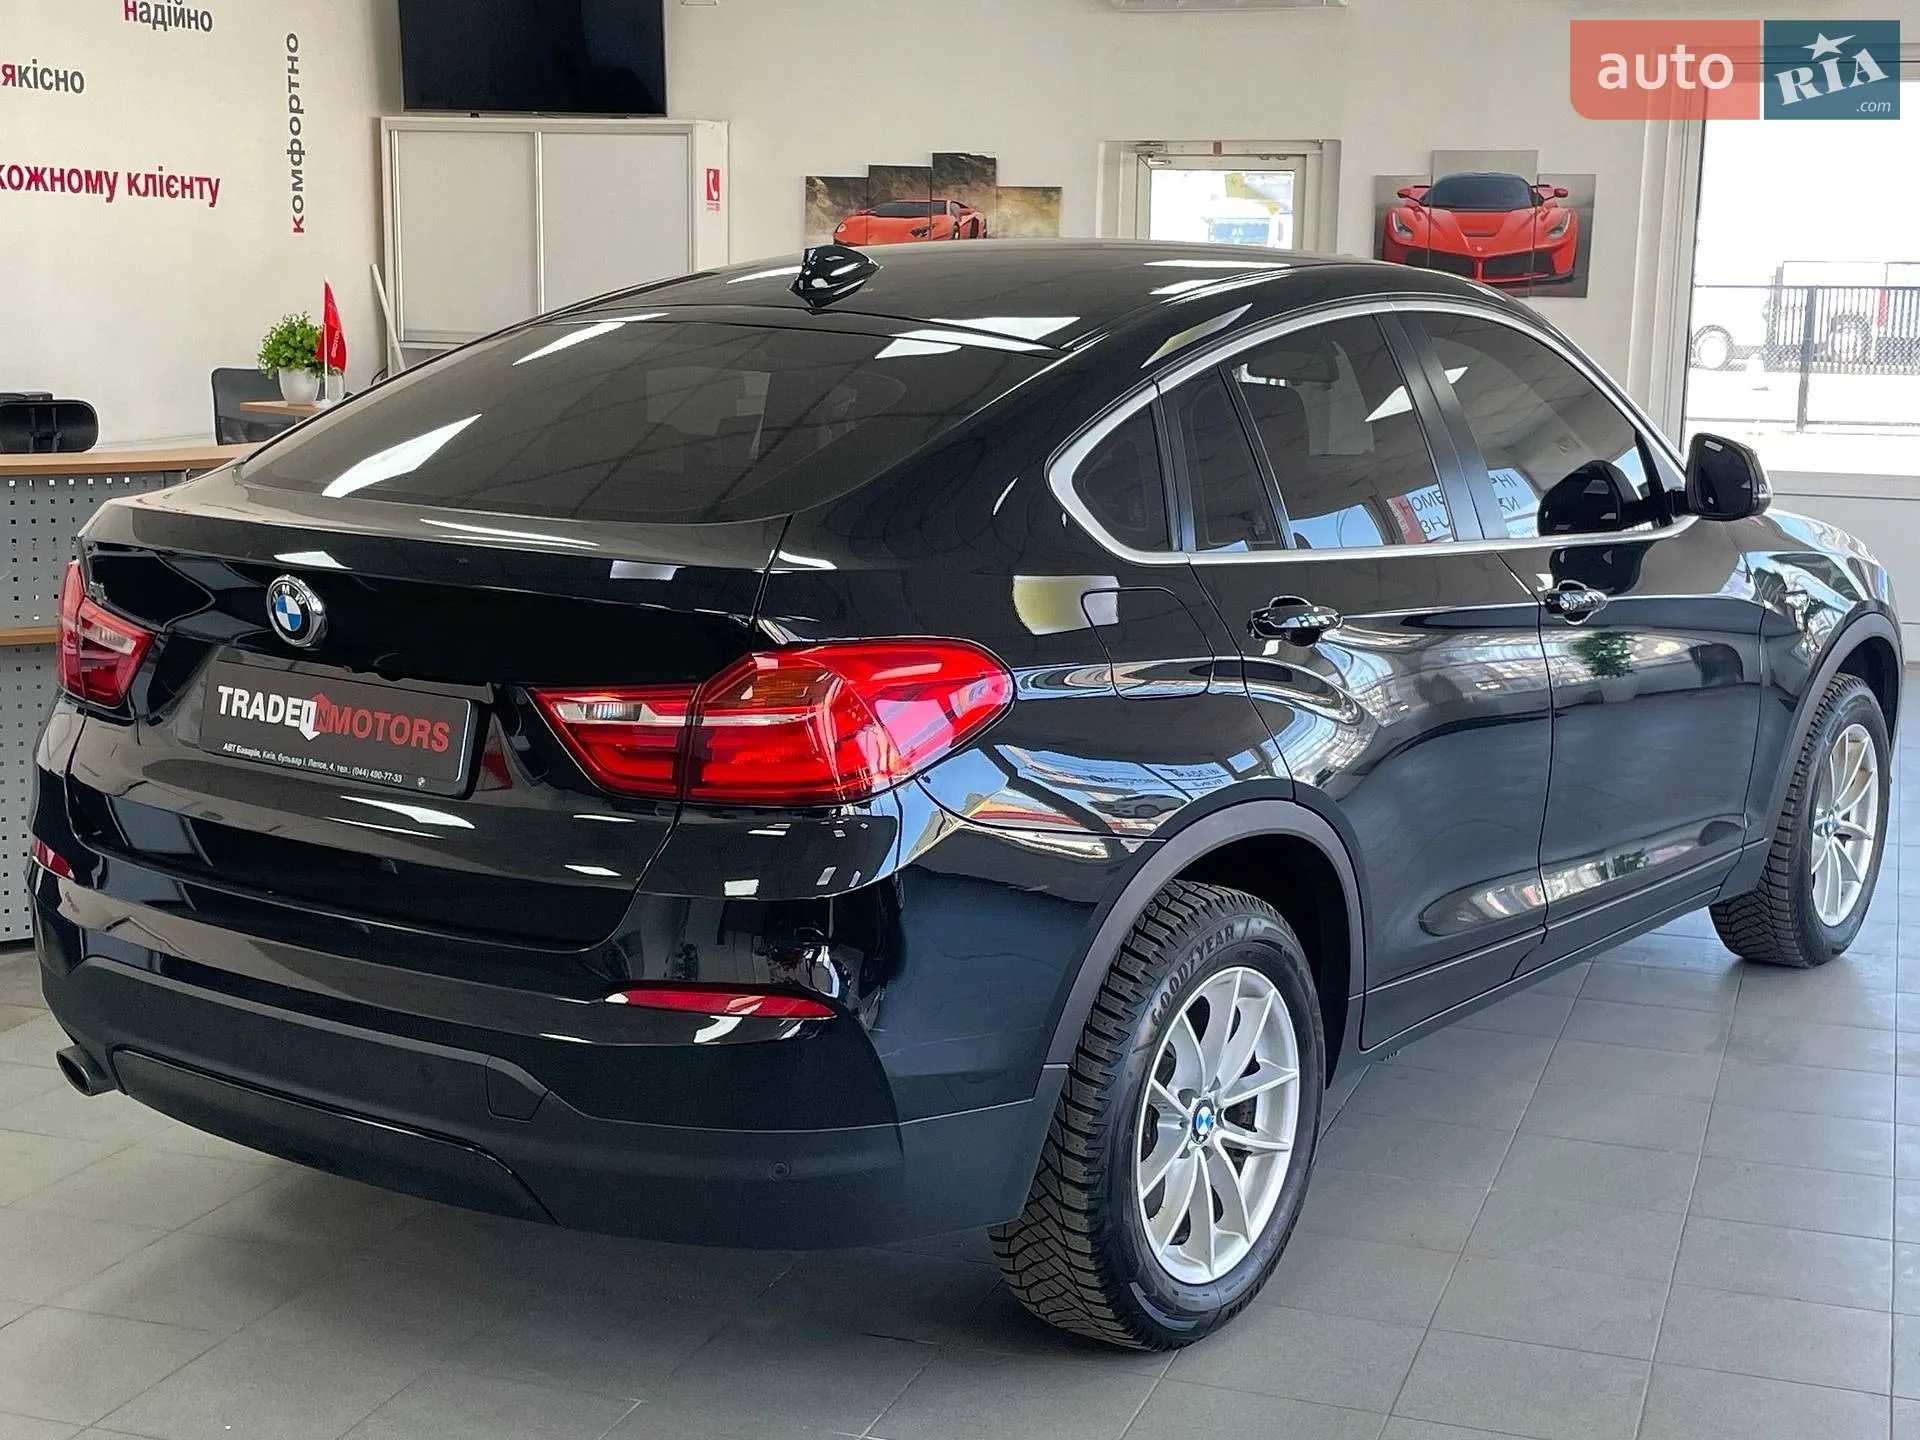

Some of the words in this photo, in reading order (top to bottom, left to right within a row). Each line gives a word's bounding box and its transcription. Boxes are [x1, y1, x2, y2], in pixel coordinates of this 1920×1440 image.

[124, 0, 213, 32] надійно
[1, 58, 85, 94] якісно
[286, 32, 305, 234] комфортно
[127, 166, 221, 208] клієнту
[217, 685, 301, 728] TRADE
[330, 704, 450, 753] MOTORS
